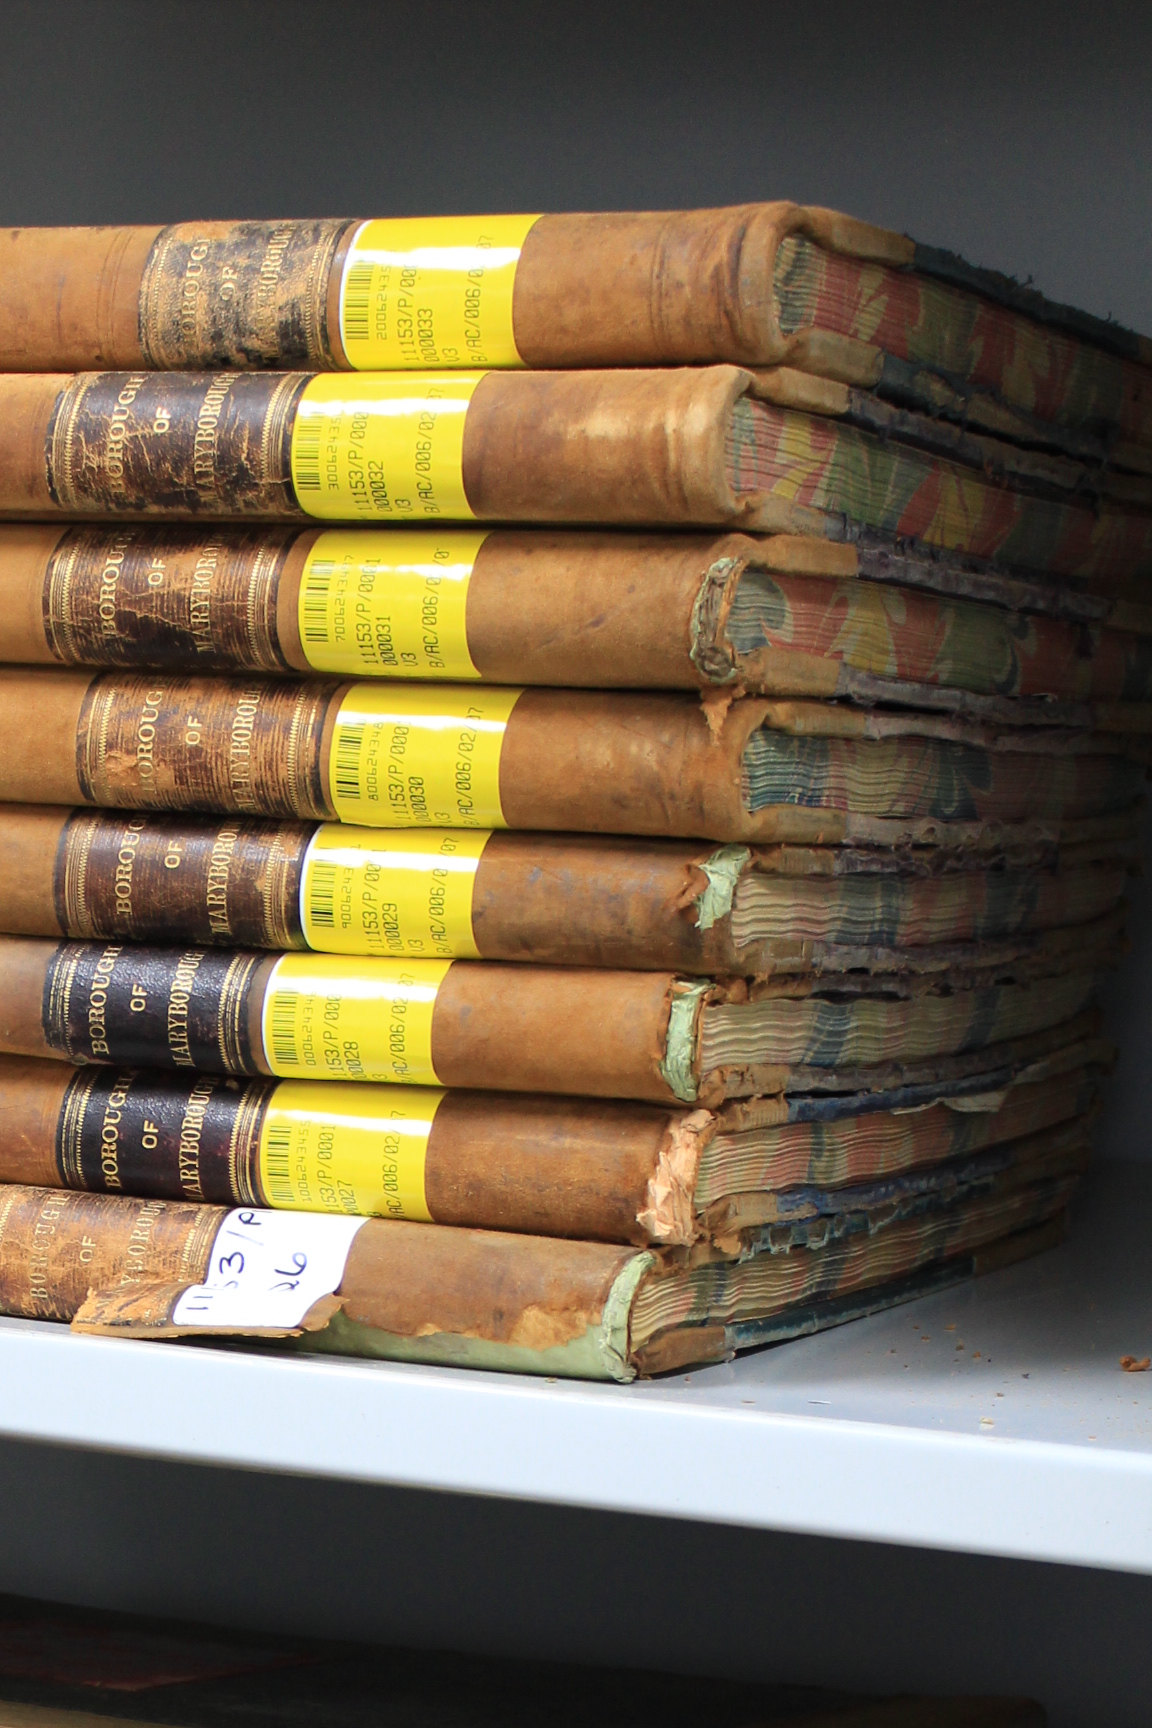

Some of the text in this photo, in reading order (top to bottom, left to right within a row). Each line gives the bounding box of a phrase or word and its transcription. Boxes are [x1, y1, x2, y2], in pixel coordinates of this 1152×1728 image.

[180, 238, 210, 336] OROUG
[219, 265, 238, 301] OF
[376, 264, 392, 341] 20062435
[397, 264, 420, 362] 11153/P/00
[417, 308, 440, 363] 000033
[152, 406, 171, 434] OF
[326, 409, 344, 492] 30062435
[347, 411, 372, 512] 11153/P/000
[367, 460, 393, 512] 000032
[98, 537, 132, 640] BOROU
[146, 557, 167, 586] OF
[189, 544, 223, 655] MARYBORO
[376, 615, 398, 667] 000031
[136, 690, 164, 792] BOROUG
[184, 714, 203, 747] OF
[228, 690, 262, 811] MARYBOROU
[365, 721, 384, 802] 800624348
[387, 720, 411, 820] 11153/P/000
[408, 776, 431, 823] 000030
[114, 819, 146, 916] BOROU
[164, 840, 183, 869] OF
[205, 821, 240, 935] MARYBORO
[428, 837, 459, 955] B/AC/006/0/07
[362, 848, 387, 951] 11153/P/001
[381, 902, 404, 952] 000029
[88, 946, 124, 1056] BOROUGH
[129, 984, 148, 1014] OF
[167, 951, 206, 1069] MARYBOROUG
[301, 991, 317, 1067] 00062434
[140, 1120, 159, 1150] OF
[178, 1078, 218, 1203] ARYBOROUG
[28, 1196, 70, 1300] BOROUGH
[79, 1235, 97, 1264] OF
